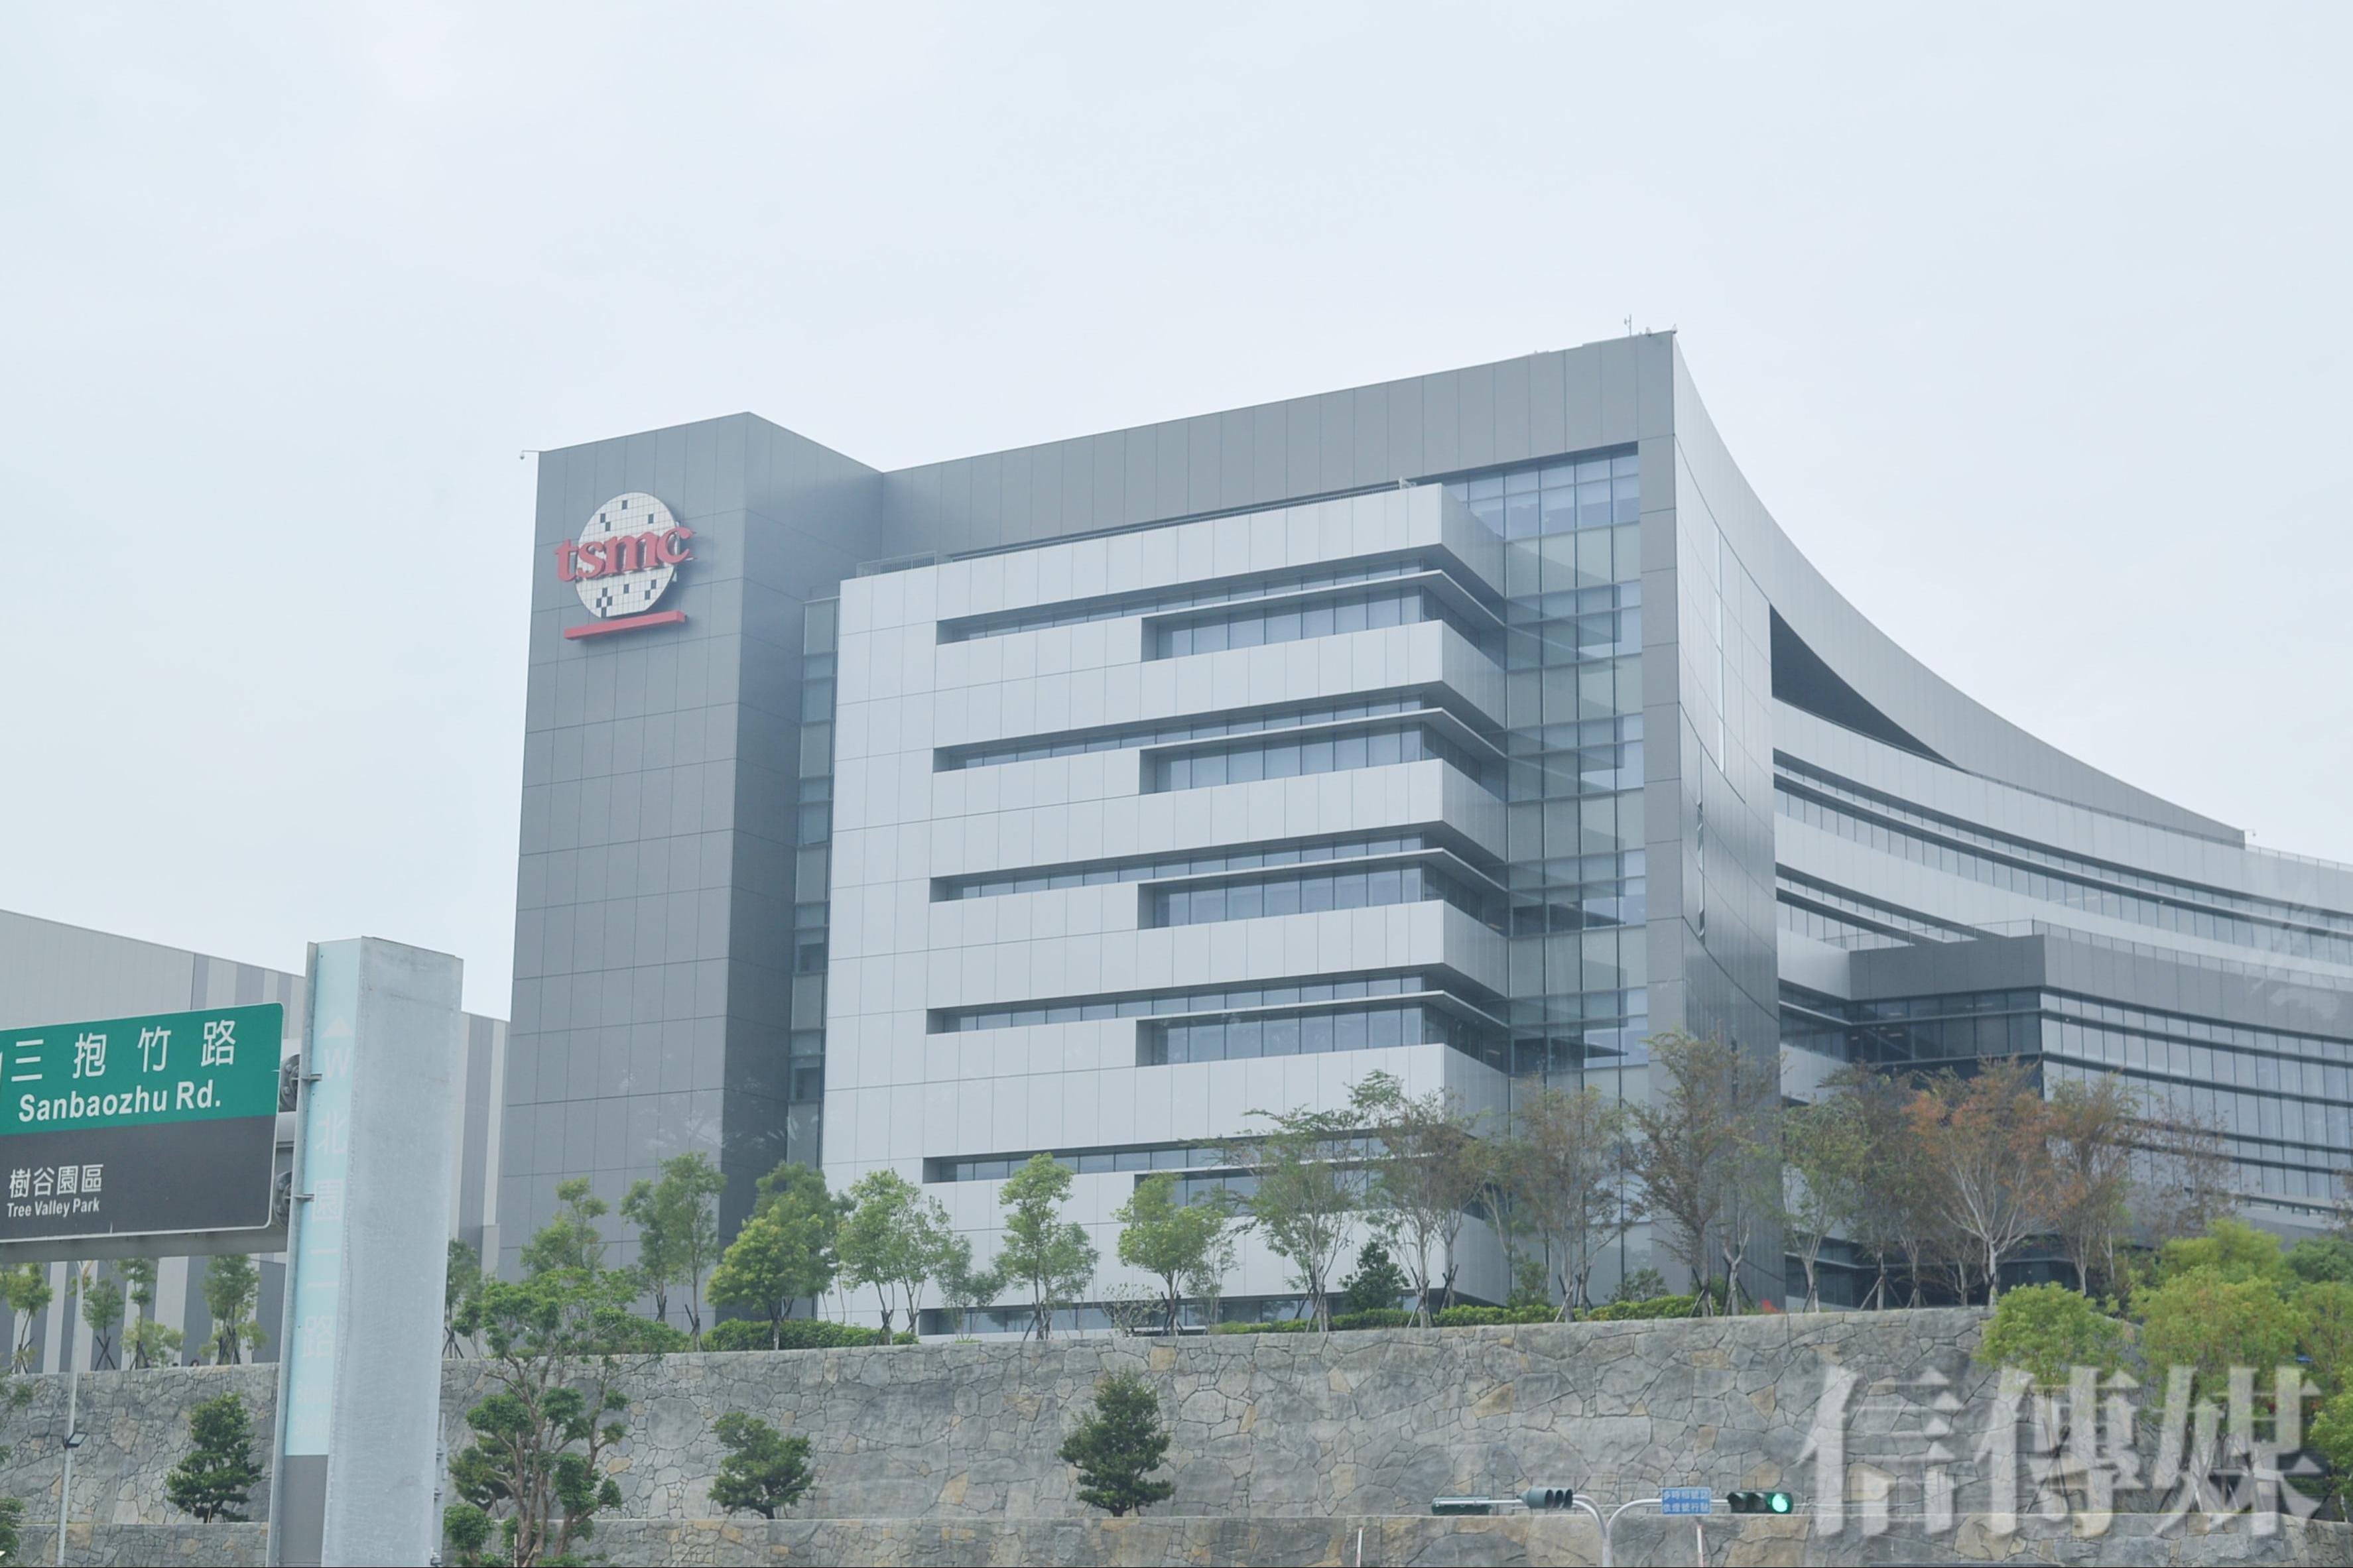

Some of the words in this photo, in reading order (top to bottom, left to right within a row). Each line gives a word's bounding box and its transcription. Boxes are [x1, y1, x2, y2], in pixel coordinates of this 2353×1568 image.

[554, 526, 692, 582] tsmc
[11, 1019, 236, 1083] 三抱竹路
[323, 1048, 351, 1079] W
[19, 1085, 168, 1122] Sanbaozhu
[176, 1079, 221, 1111] Rd.
[9, 1164, 103, 1199] 樹谷園區
[7, 1202, 32, 1217] Tree
[34, 1199, 70, 1217] Valley
[73, 1197, 99, 1213] Park
[302, 1111, 348, 1358] 北園二路
